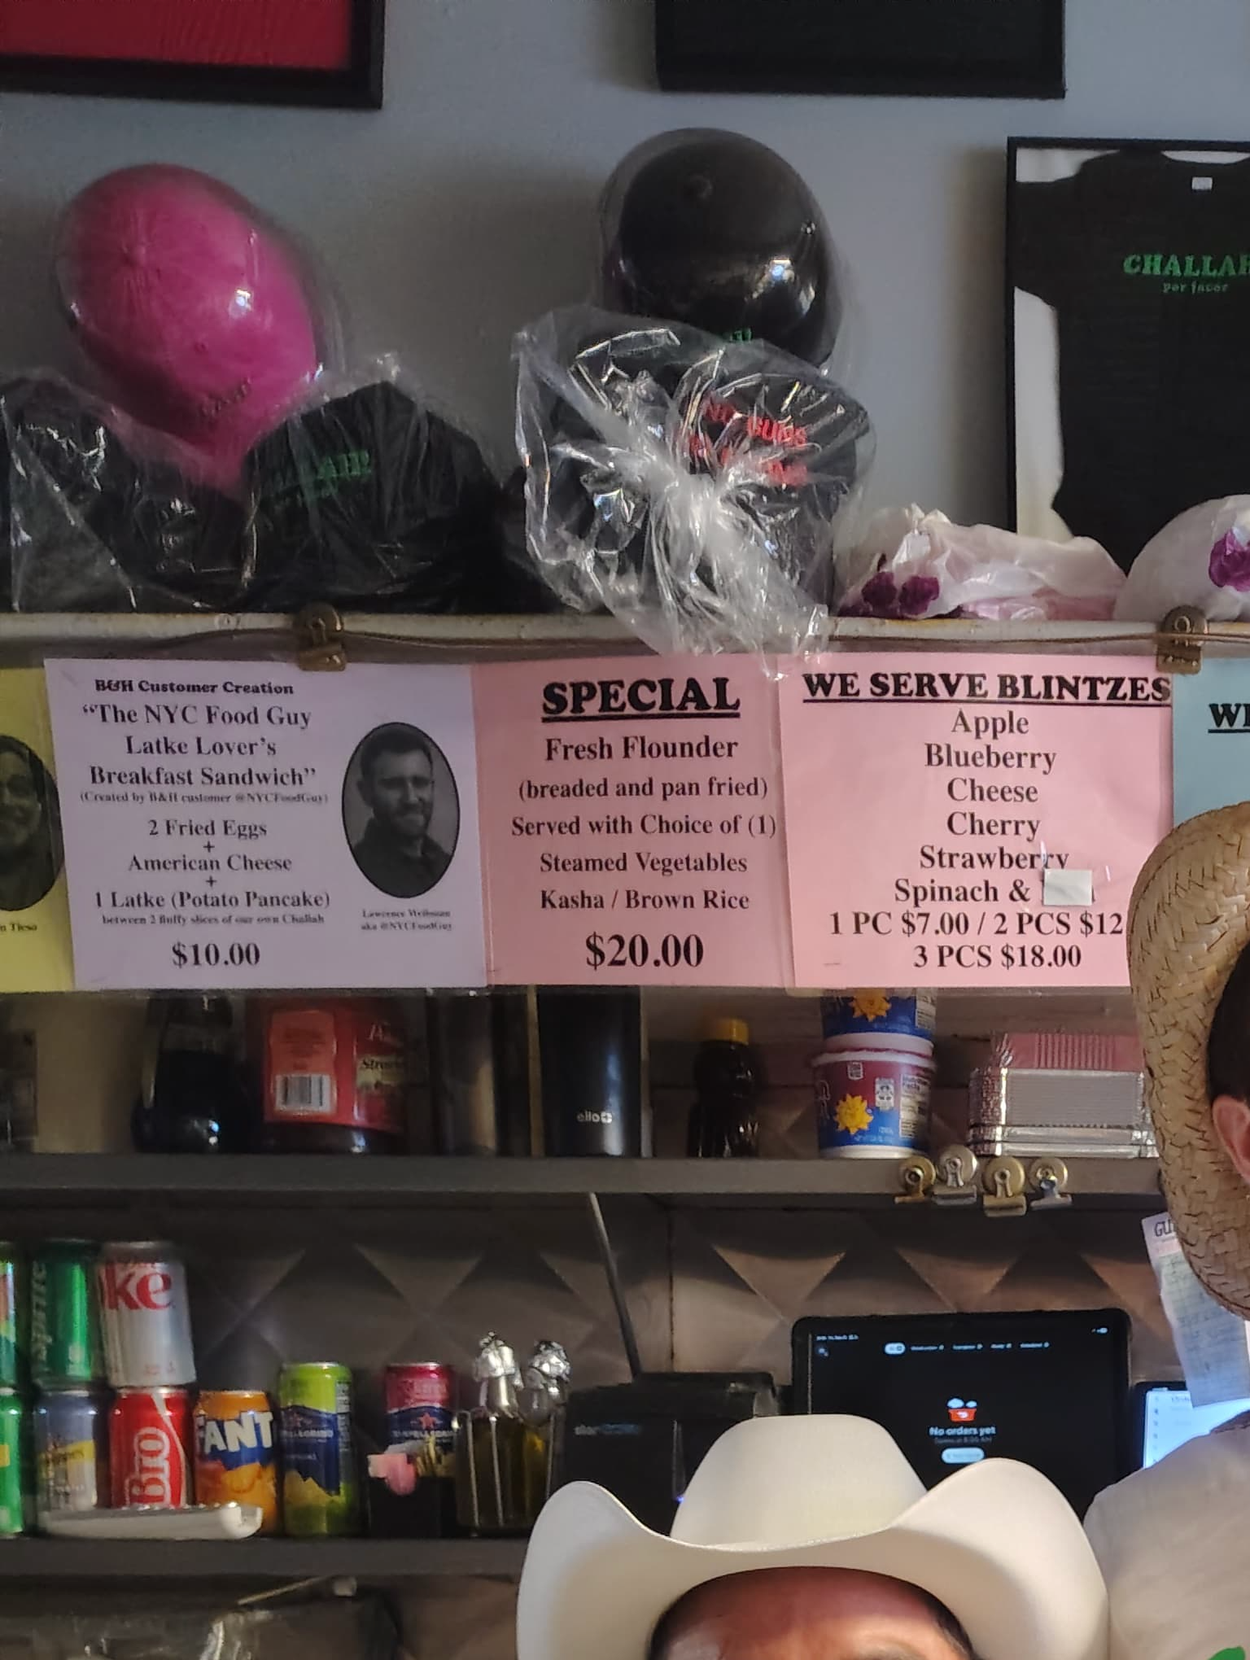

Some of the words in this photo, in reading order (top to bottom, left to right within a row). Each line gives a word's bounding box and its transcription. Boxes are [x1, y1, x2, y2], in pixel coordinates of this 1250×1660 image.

[1163, 282, 1186, 294] por
[95, 679, 133, 692] B&H
[138, 680, 218, 694] Customer
[222, 681, 294, 695] Creation
[543, 677, 741, 716] SPECIAL
[802, 672, 860, 698] WE
[869, 673, 988, 698] SERVE
[997, 673, 1171, 702] BLINTZES
[145, 704, 197, 724] NYC
[206, 705, 259, 725] Food
[266, 706, 312, 729] Guy
[951, 708, 1030, 740] Apple
[126, 735, 188, 755] Latke
[545, 737, 613, 761] Fresh
[622, 735, 739, 759] Flounder
[925, 742, 1057, 775] Blueberry
[90, 765, 194, 785] Breakfast
[519, 778, 608, 802] (breaded
[616, 777, 654, 797] and
[662, 782, 700, 801] pan
[708, 776, 768, 799] fried)
[947, 777, 1039, 803] Cheese
[149, 820, 159, 836] 2
[166, 819, 216, 836] Fried
[223, 820, 267, 840] Eggs
[511, 816, 581, 836] Served
[588, 815, 633, 834] with
[640, 814, 713, 834] Choice
[720, 814, 742, 834] of
[748, 814, 777, 838] (1)
[947, 811, 1041, 842] Cherry
[128, 854, 220, 871] American
[227, 855, 292, 871] Cheese
[540, 852, 627, 872] Steamed
[636, 852, 748, 877] Vegetables
[920, 845, 1070, 870] Strawberry
[95, 892, 102, 908] 1
[111, 891, 165, 908] Latke
[171, 891, 239, 910] (Potato
[246, 890, 330, 909] Pancake)
[541, 889, 605, 909] Kasha
[625, 889, 695, 909] Brown
[703, 889, 750, 909] Rice
[895, 878, 998, 908] Spinach
[1009, 879, 1031, 902] &
[103, 915, 147, 925] between
[222, 914, 233, 925] of
[830, 911, 843, 935] 1
[852, 911, 893, 935] PC
[902, 910, 969, 937] $7.00
[994, 911, 1008, 935] 2
[1016, 911, 1071, 935] PCS
[172, 942, 260, 969] $10.00
[586, 931, 704, 971] $20.00
[914, 944, 928, 968] 3
[937, 944, 992, 968] PCS
[1001, 944, 1082, 970] $18.00
[102, 1262, 172, 1311] ke
[196, 1411, 274, 1454] FANT
[929, 1426, 945, 1436] No
[947, 1426, 978, 1436] orders
[979, 1426, 996, 1438] yet
